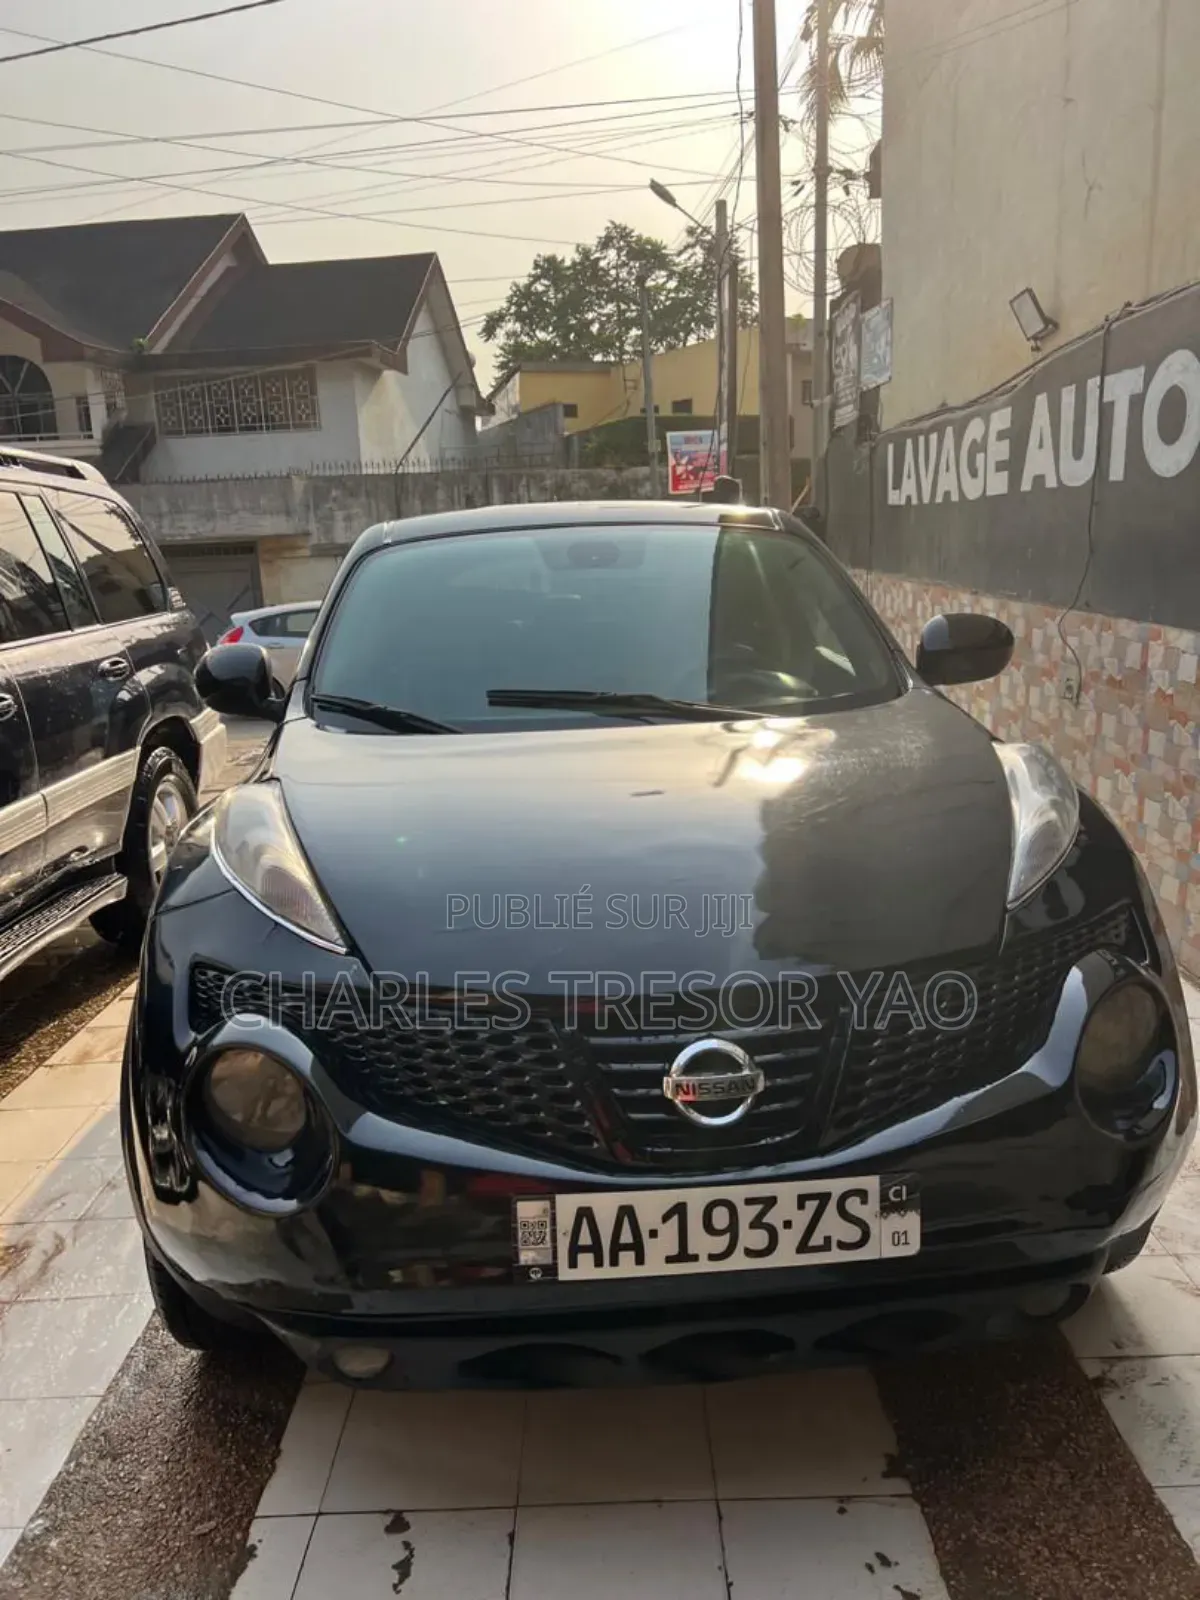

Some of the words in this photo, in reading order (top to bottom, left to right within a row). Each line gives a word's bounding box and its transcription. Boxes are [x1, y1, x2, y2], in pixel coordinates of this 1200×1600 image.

[887, 406, 1012, 505] LAVAGE
[1020, 348, 1200, 492] AUTO
[675, 1079, 755, 1096] NISSAN
[888, 1184, 907, 1201] CI
[891, 1229, 910, 1247] 01
